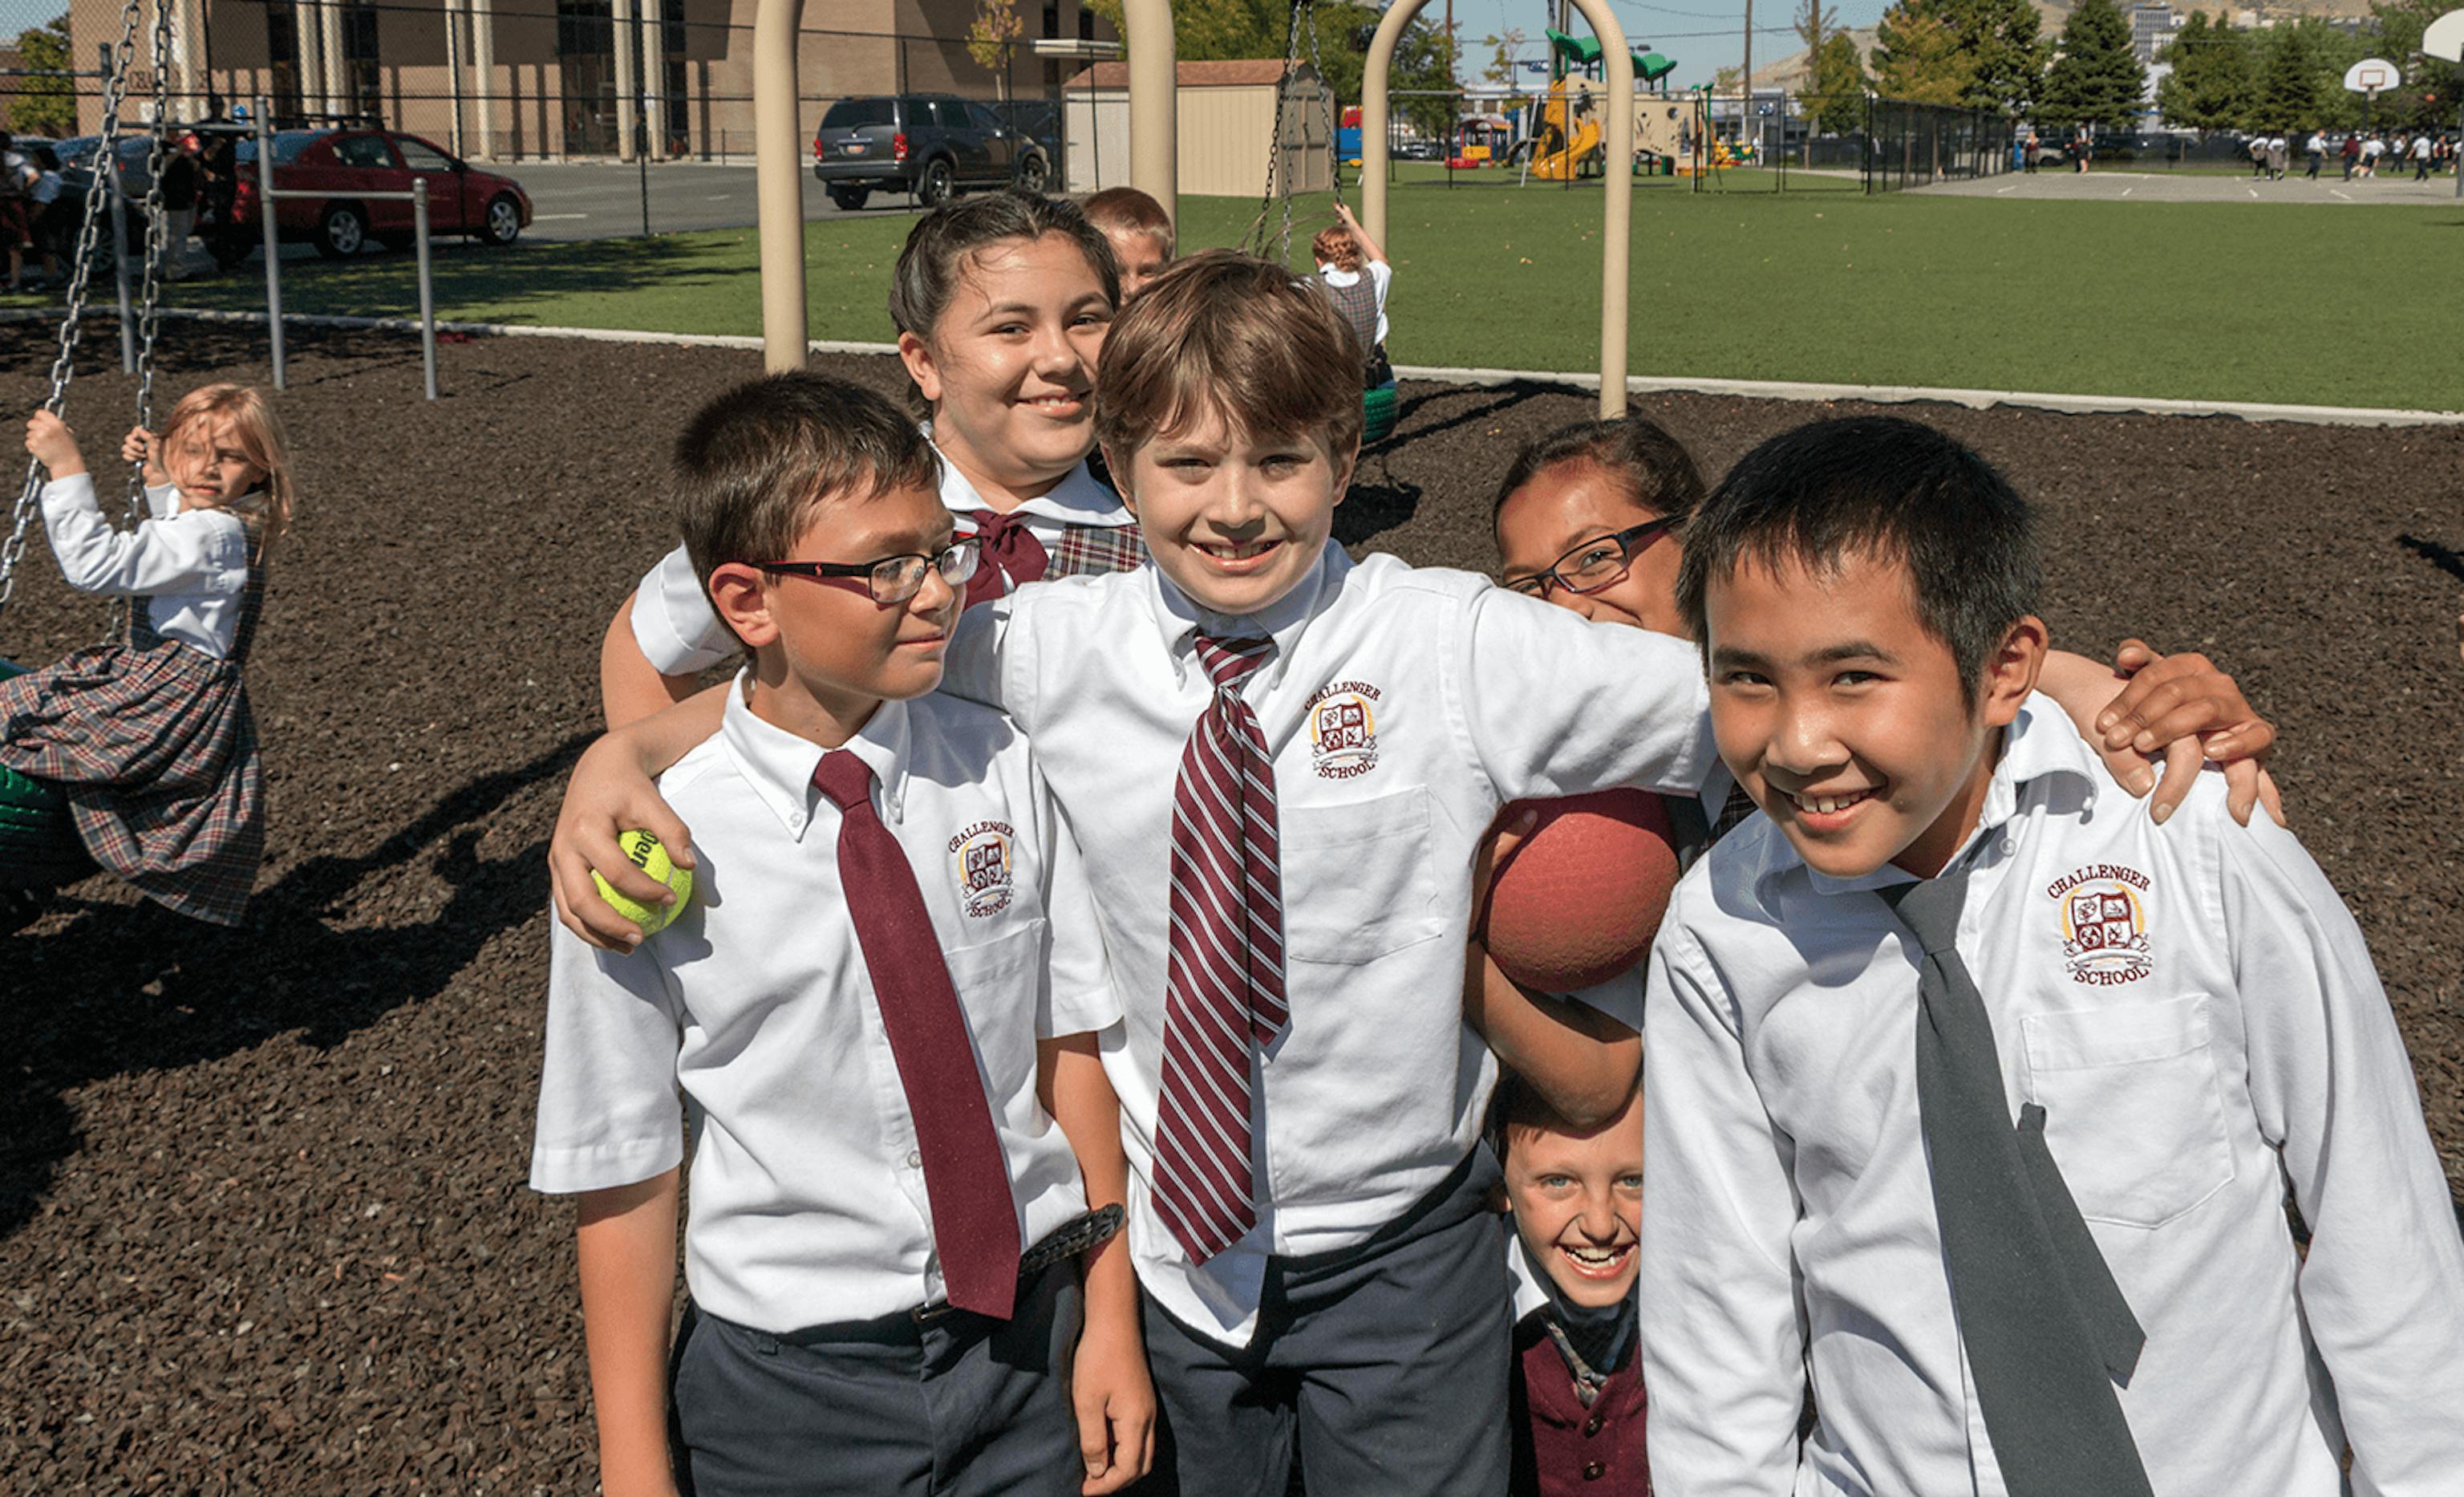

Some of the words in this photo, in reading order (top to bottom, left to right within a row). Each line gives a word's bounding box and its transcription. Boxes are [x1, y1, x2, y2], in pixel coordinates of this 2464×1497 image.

[1305, 681, 1381, 711] CHALLENGER
[1318, 761, 1375, 779] SCHOOL
[948, 821, 1015, 853] CHALLENGER
[2047, 864, 2150, 899] CHALLENGER
[970, 897, 1011, 918] SCHOOL
[2073, 966, 2149, 985] SCHOOL
